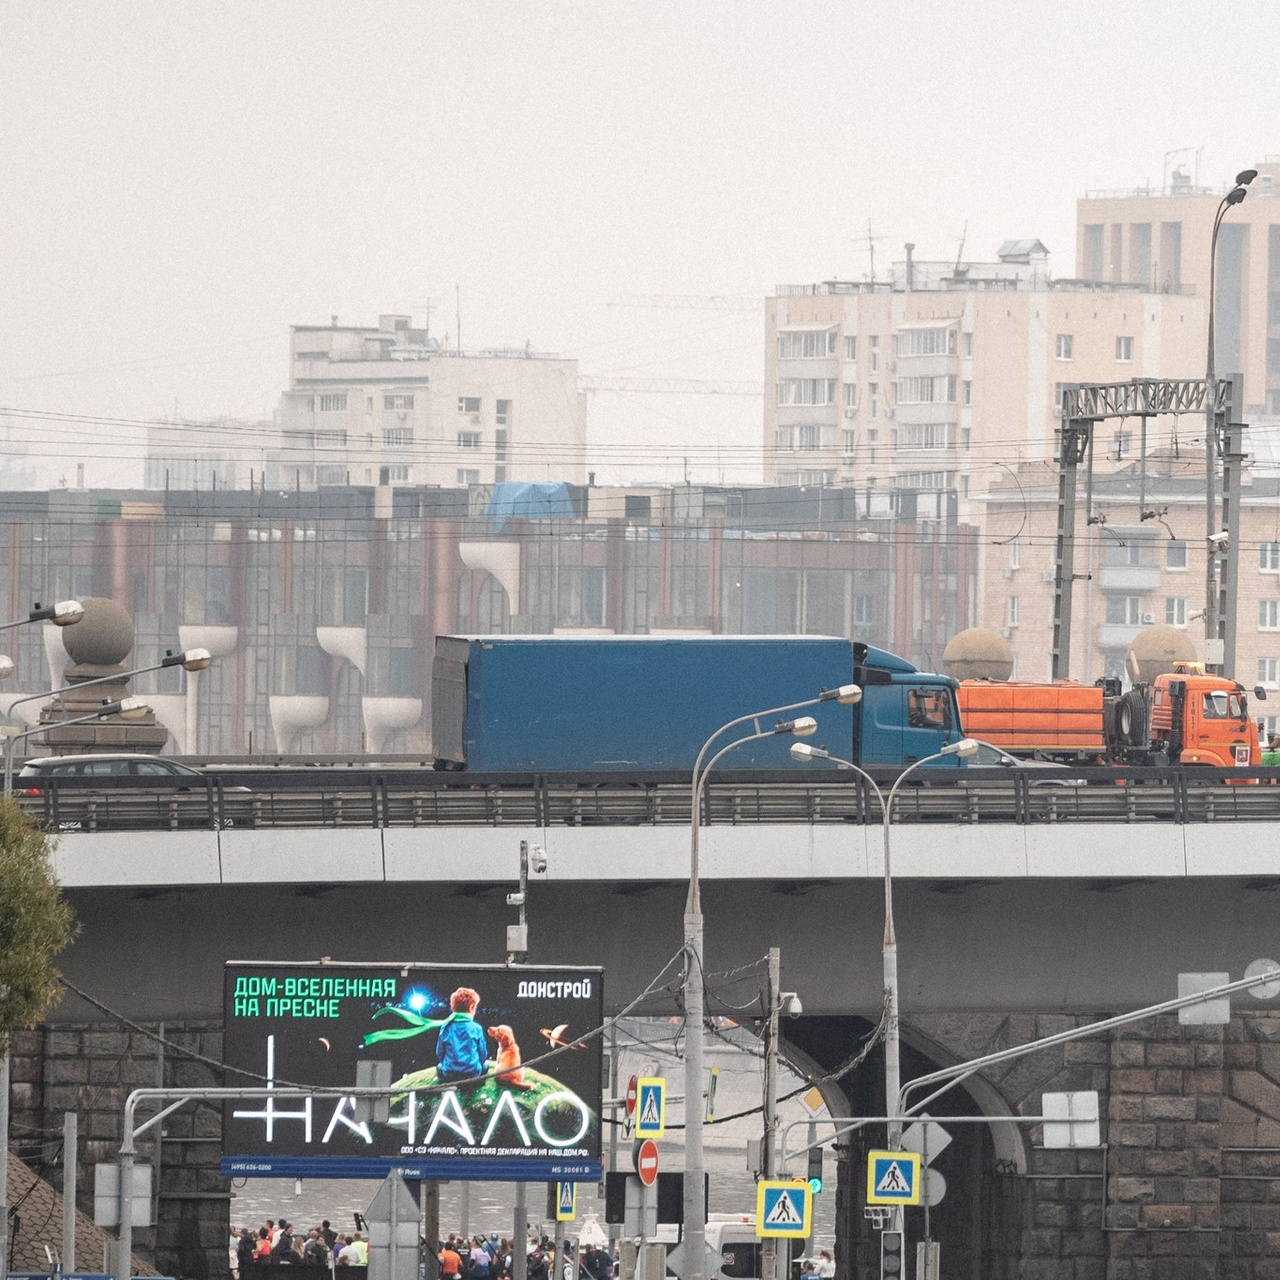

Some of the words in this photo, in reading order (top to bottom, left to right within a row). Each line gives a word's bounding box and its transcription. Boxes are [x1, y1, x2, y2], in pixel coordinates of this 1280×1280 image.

[234, 977, 396, 997] ДОМ-ВСЕЛЕННАЯ
[516, 978, 591, 998] ДОНСТРОЙ
[234, 998, 259, 1017] НА
[266, 998, 340, 1018] ПРЕСНЕ
